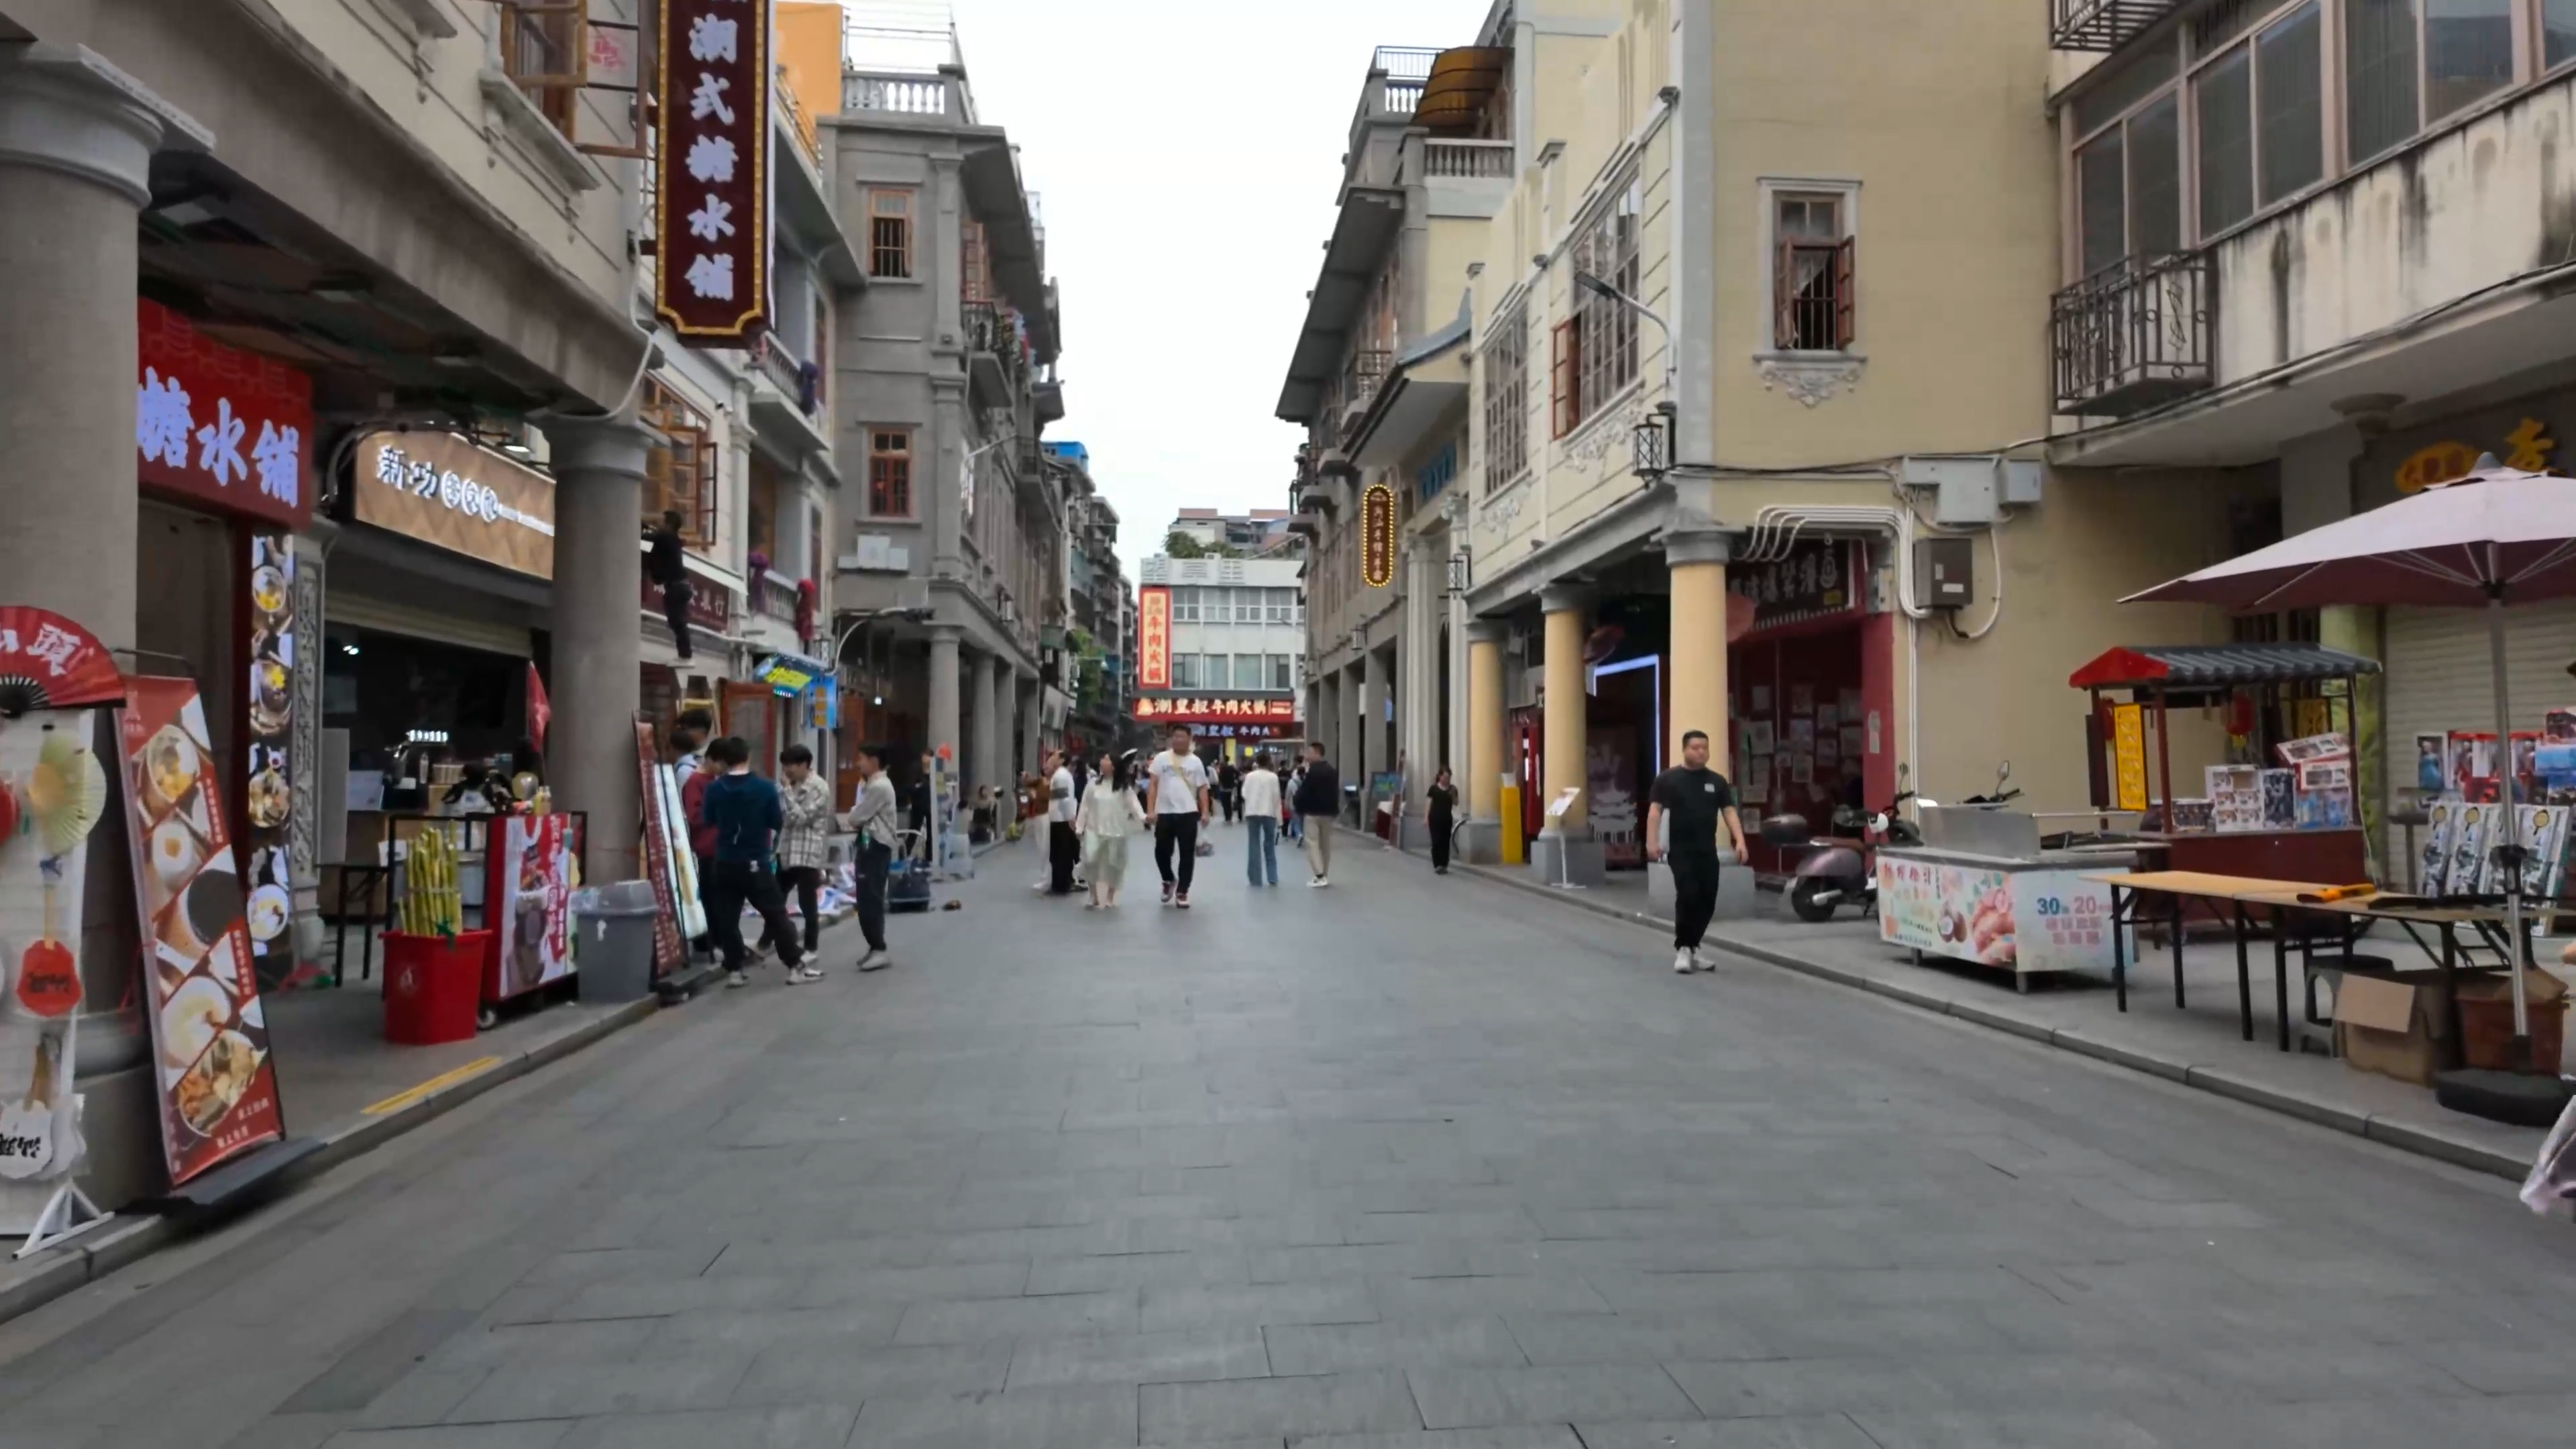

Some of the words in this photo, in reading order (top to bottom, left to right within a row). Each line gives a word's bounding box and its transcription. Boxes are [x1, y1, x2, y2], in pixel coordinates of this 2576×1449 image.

[686, 0, 739, 302] 潮式糖水鋪
